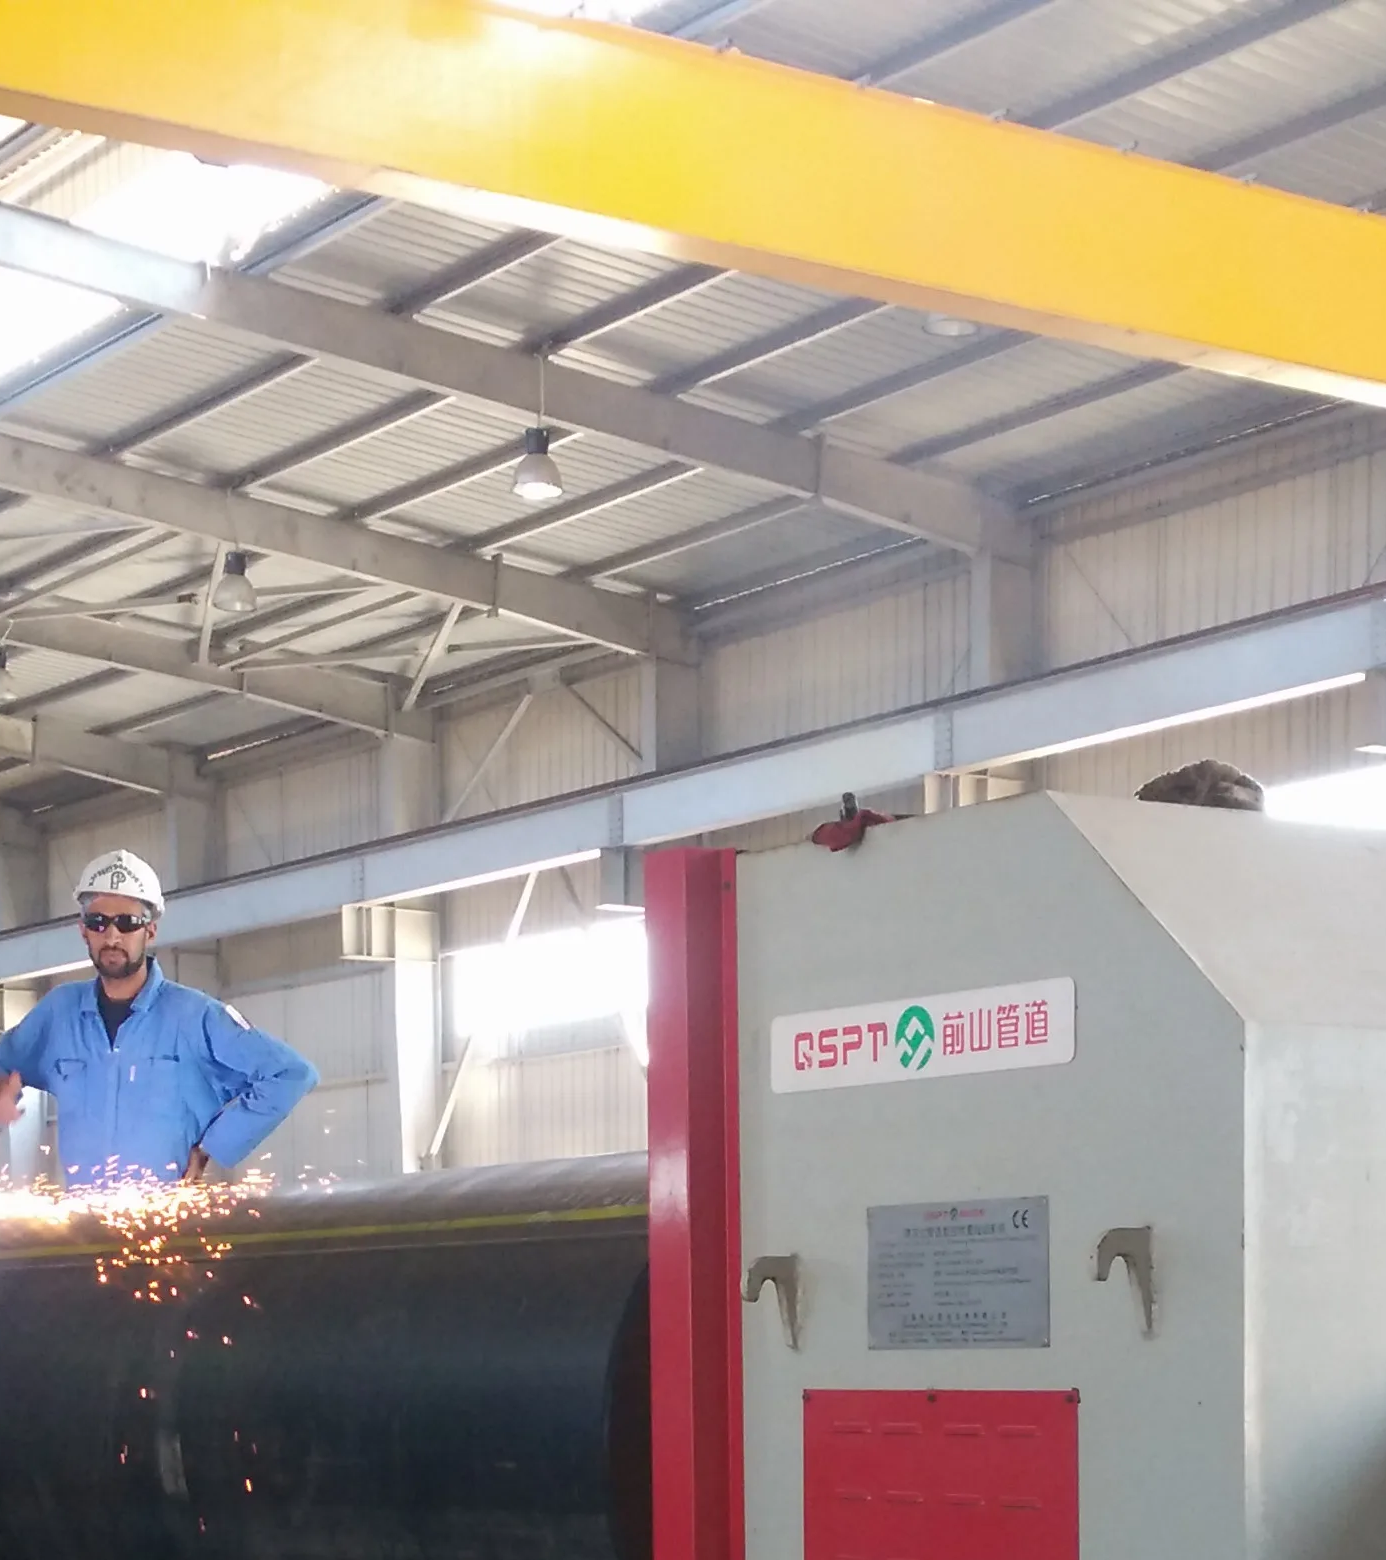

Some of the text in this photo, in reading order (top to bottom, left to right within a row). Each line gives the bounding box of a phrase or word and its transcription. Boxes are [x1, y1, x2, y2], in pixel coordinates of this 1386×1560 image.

[794, 1021, 889, 1071] QSPT
[942, 999, 1049, 1056] 前山管道
